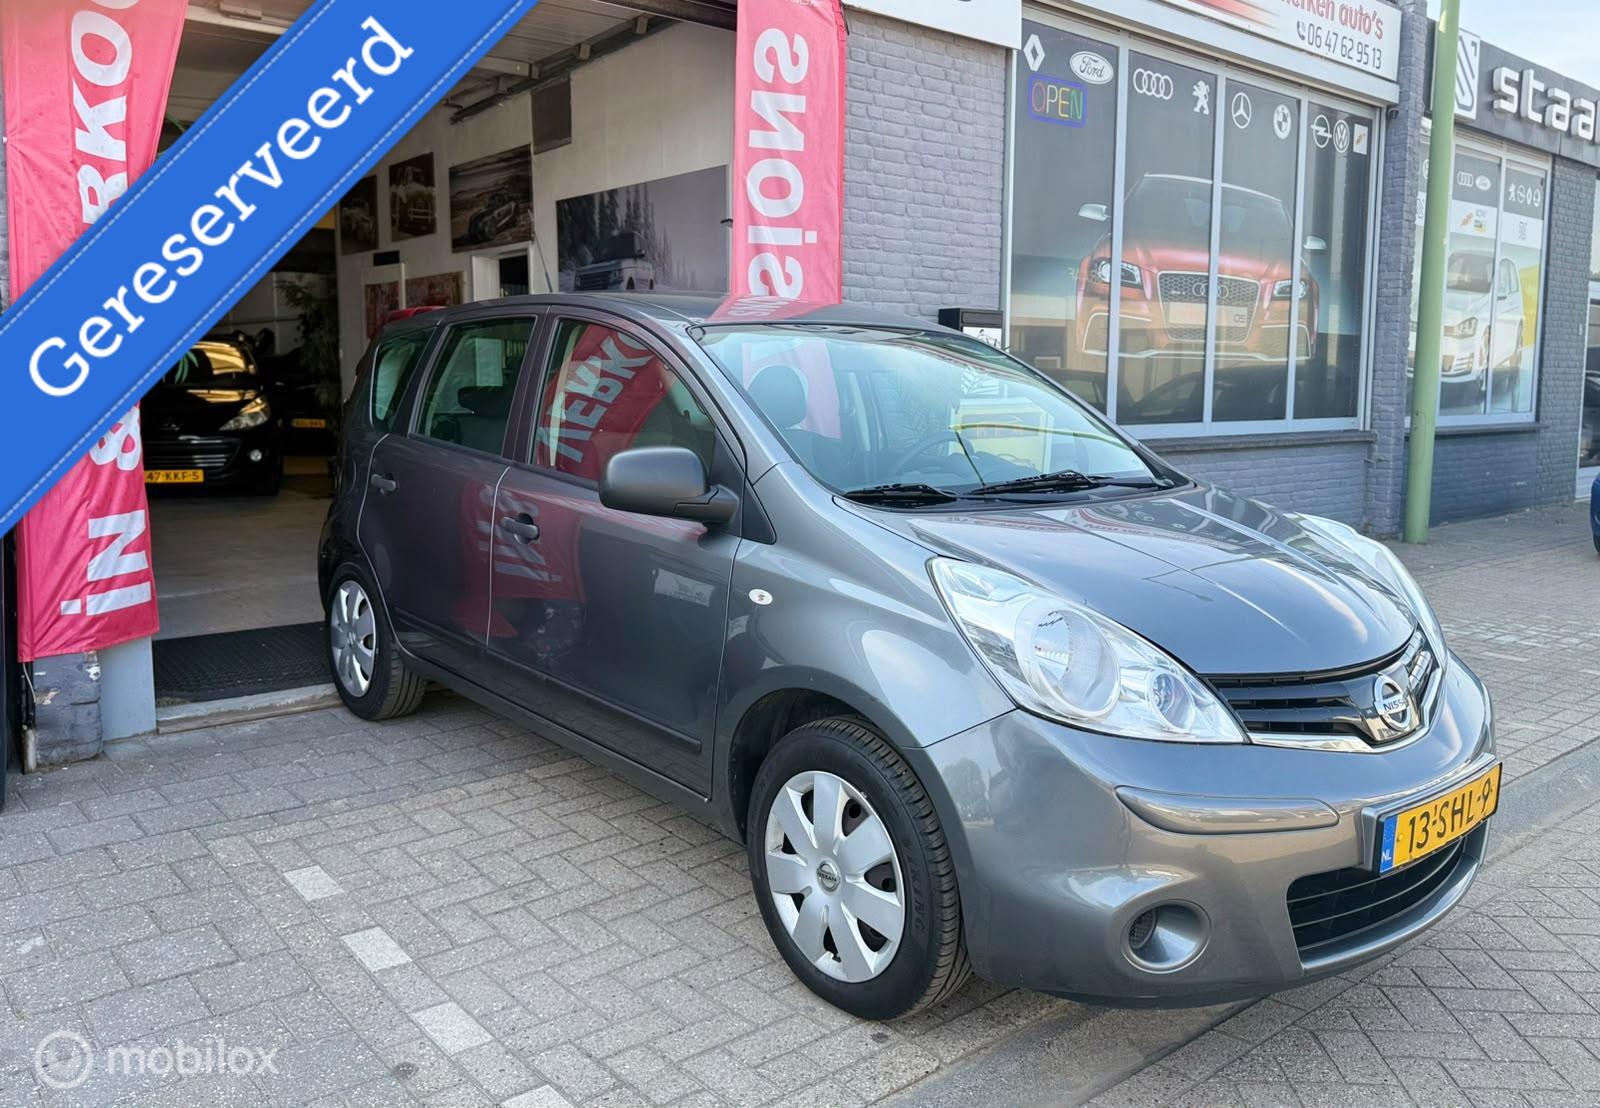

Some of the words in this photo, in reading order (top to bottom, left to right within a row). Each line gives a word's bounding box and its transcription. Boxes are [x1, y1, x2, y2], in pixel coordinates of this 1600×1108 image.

[1338, 3, 1384, 40] auto's
[1307, 23, 1322, 49] 06
[1325, 30, 1339, 54] 47
[1341, 36, 1354, 60] 62
[1357, 41, 1369, 66] 95
[1372, 47, 1382, 70] 13
[1079, 55, 1105, 78] Ford
[71, 0, 140, 225] RKO
[1031, 81, 1083, 120] OPEN
[1493, 66, 1600, 143] staa
[147, 470, 200, 482] 47-KKF-5
[1383, 696, 1407, 711] NISS
[1408, 777, 1493, 853] 13-SHL-9
[1381, 850, 1392, 863] NL
